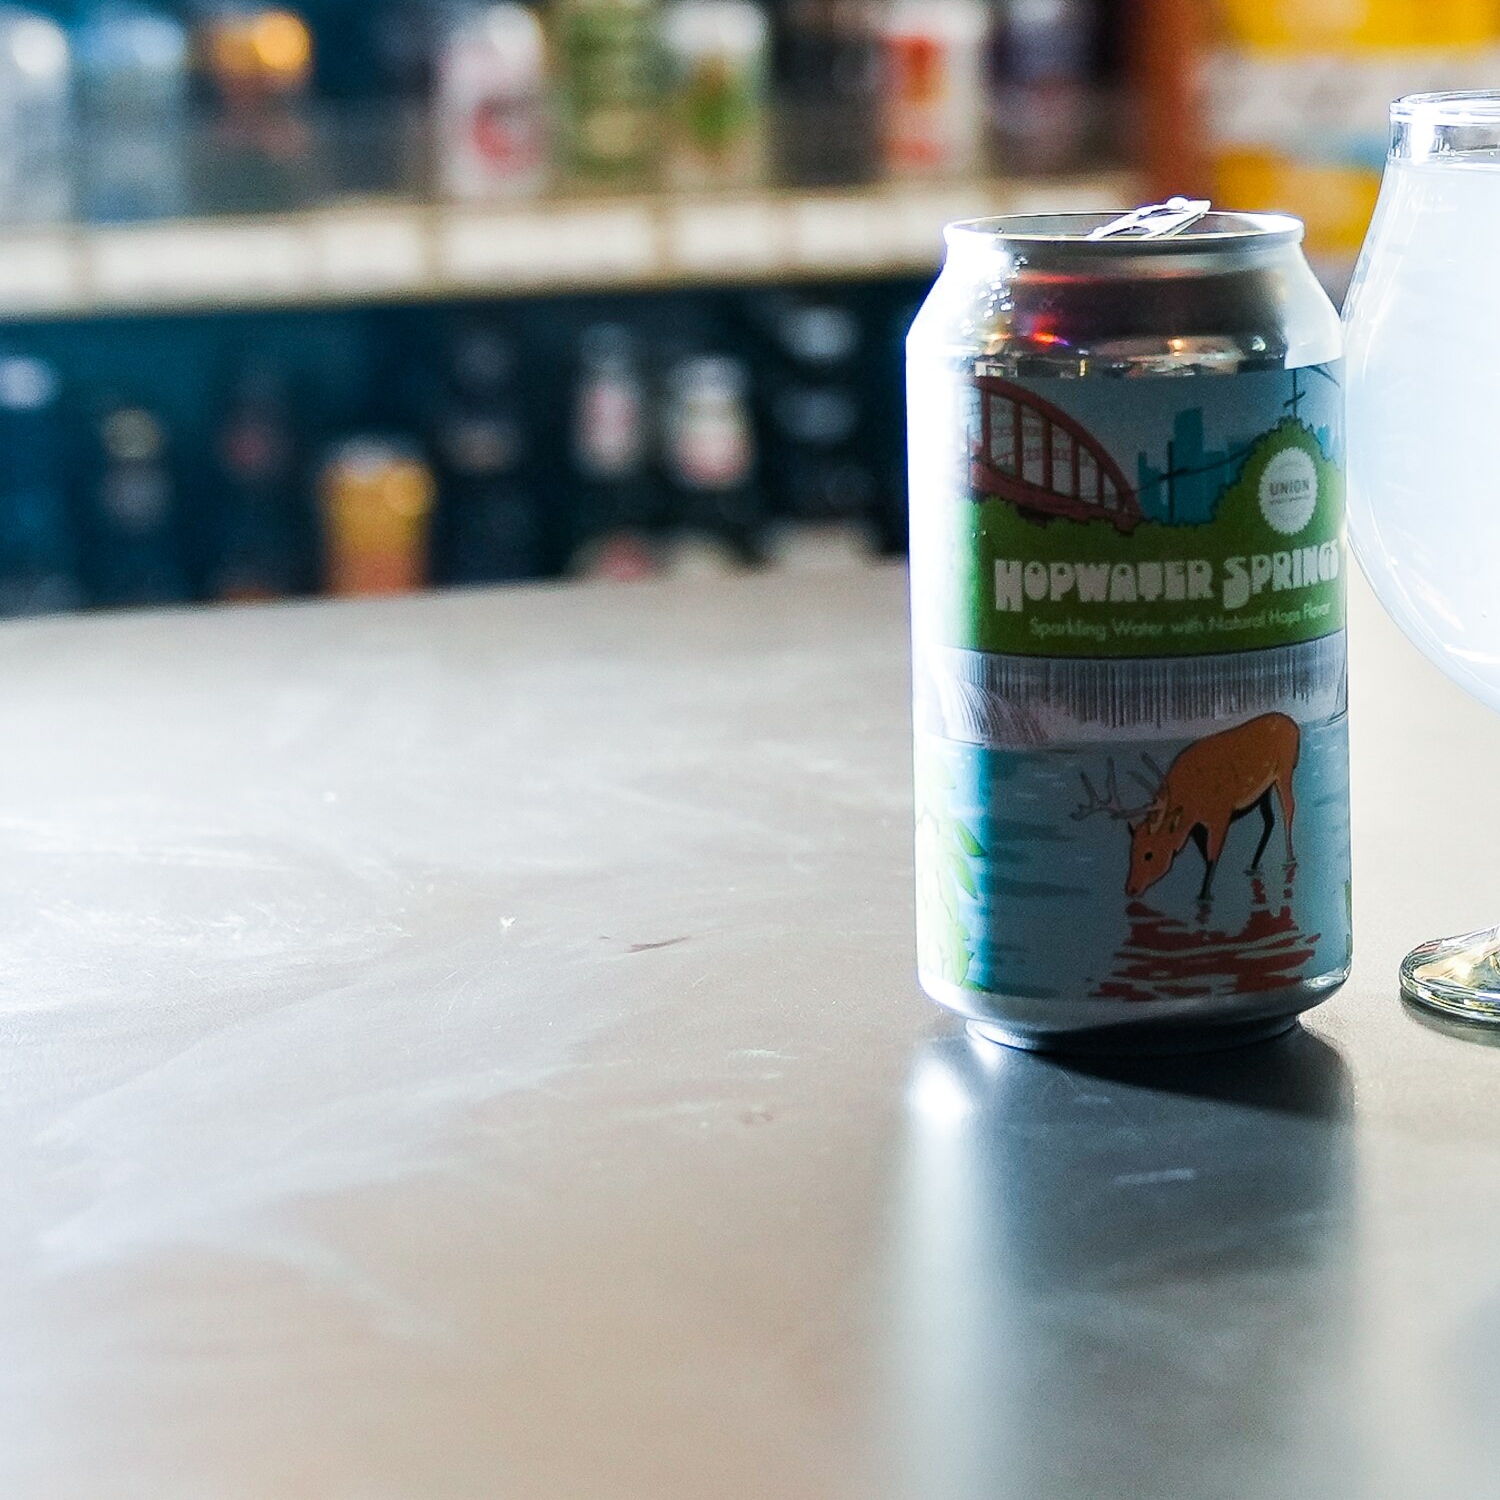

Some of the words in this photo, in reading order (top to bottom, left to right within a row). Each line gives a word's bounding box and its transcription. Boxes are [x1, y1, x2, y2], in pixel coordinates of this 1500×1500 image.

[994, 558, 1214, 612] HOPWATER
[1222, 538, 1339, 610] SPRINGS
[1029, 614, 1107, 642] Sparkling
[1110, 616, 1164, 637] Water
